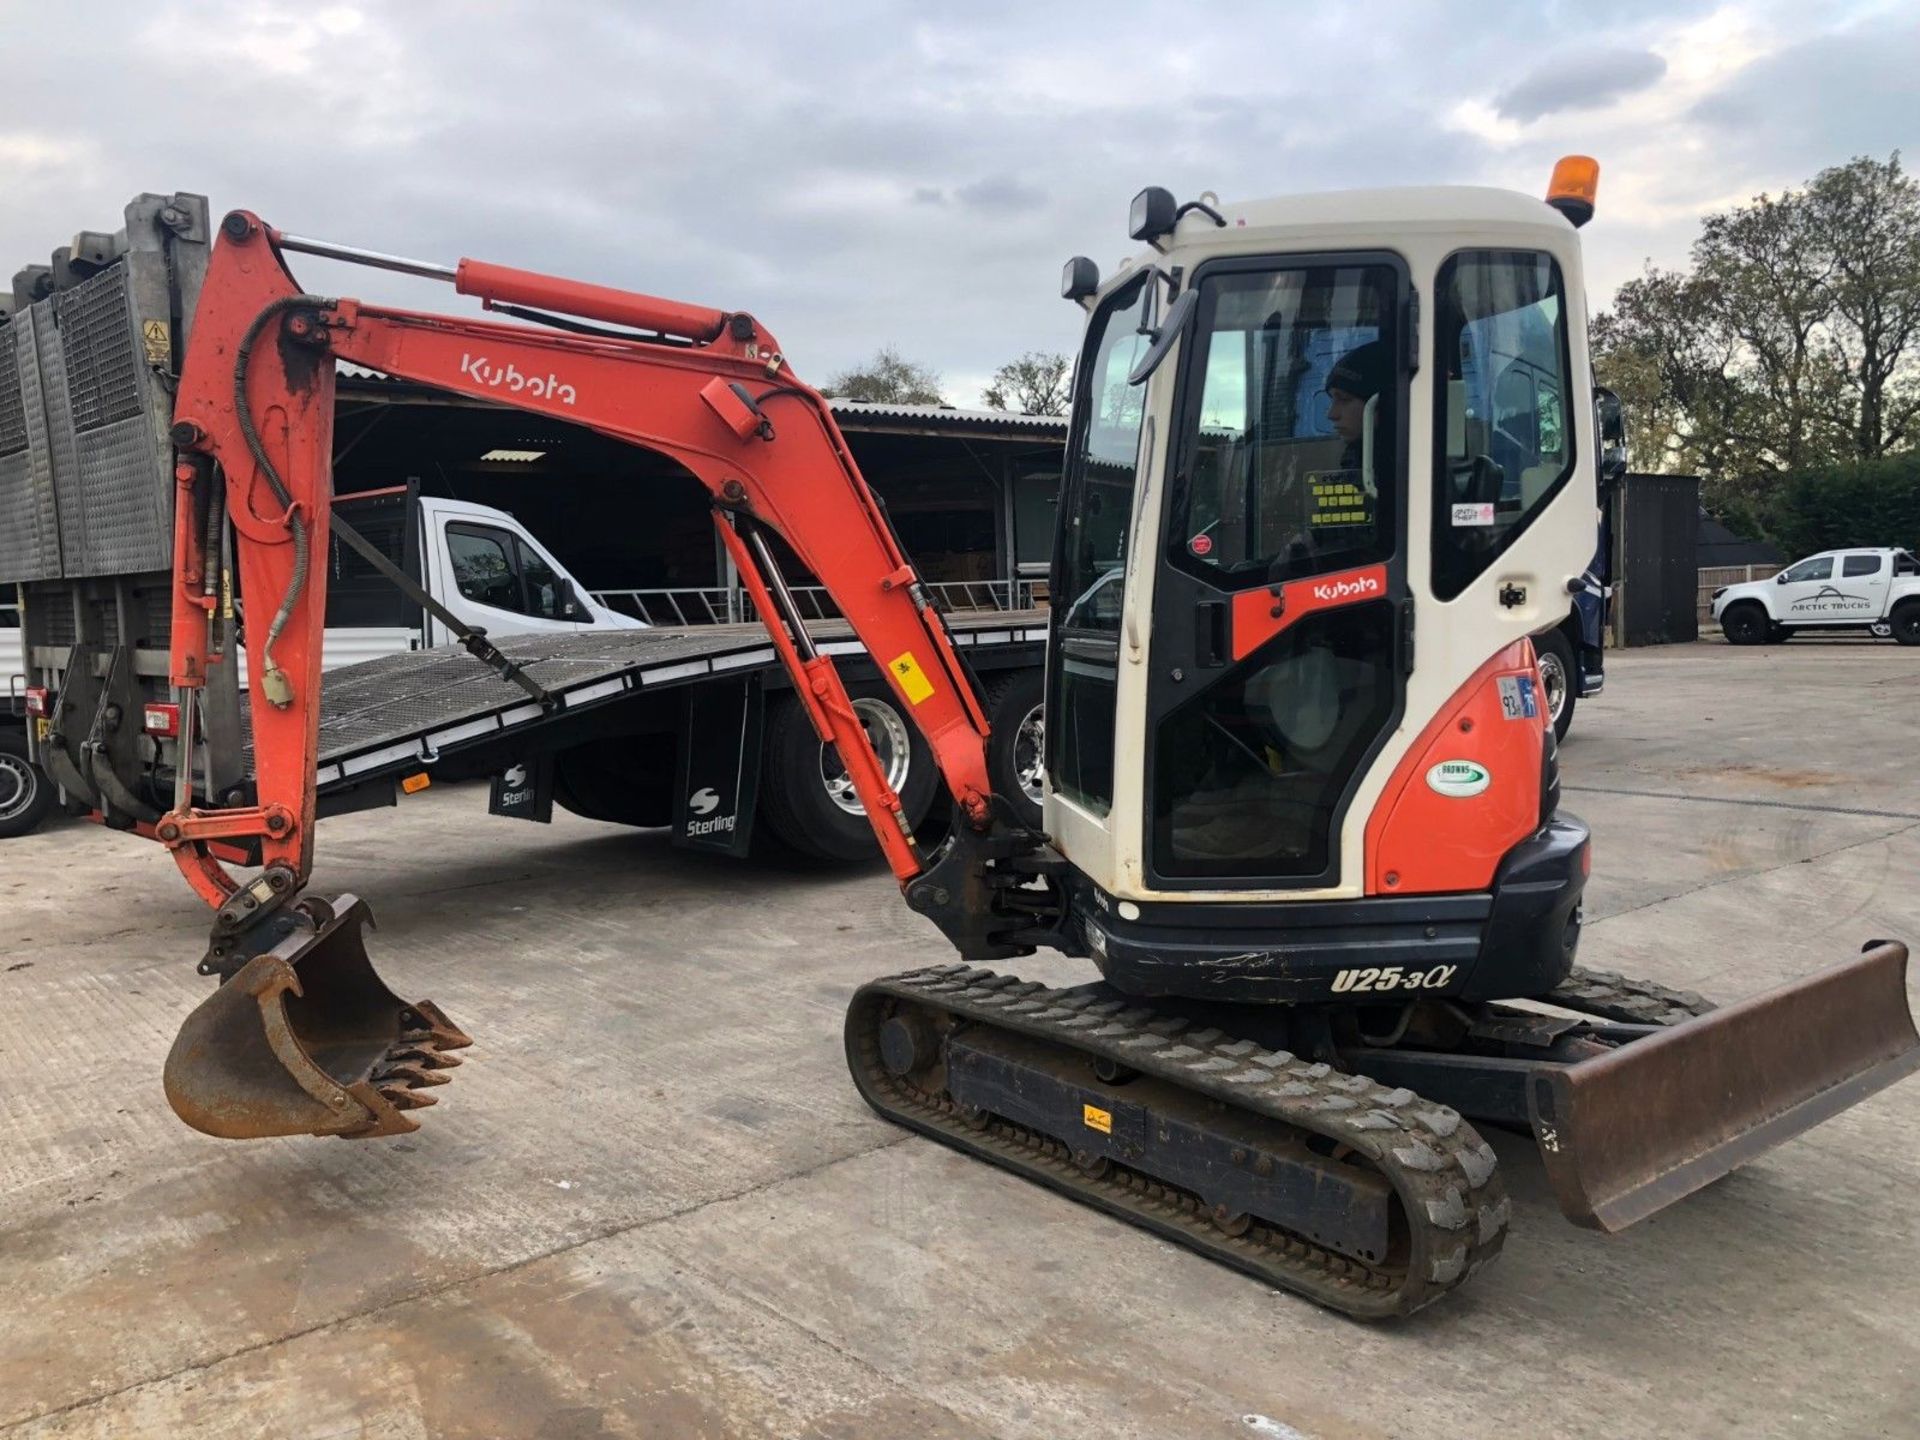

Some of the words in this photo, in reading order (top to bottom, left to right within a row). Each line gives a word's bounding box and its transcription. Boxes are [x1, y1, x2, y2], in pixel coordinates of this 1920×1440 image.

[461, 353, 577, 405] Kubota
[1313, 577, 1378, 600] Kubota
[1791, 603, 1829, 611] ARCTIC
[1831, 602, 1871, 610] TRUCKS
[1502, 695, 1517, 716] 93
[1442, 765, 1470, 774] BROWNS
[502, 787, 535, 807] Sterlin
[686, 815, 736, 837] Sterling
